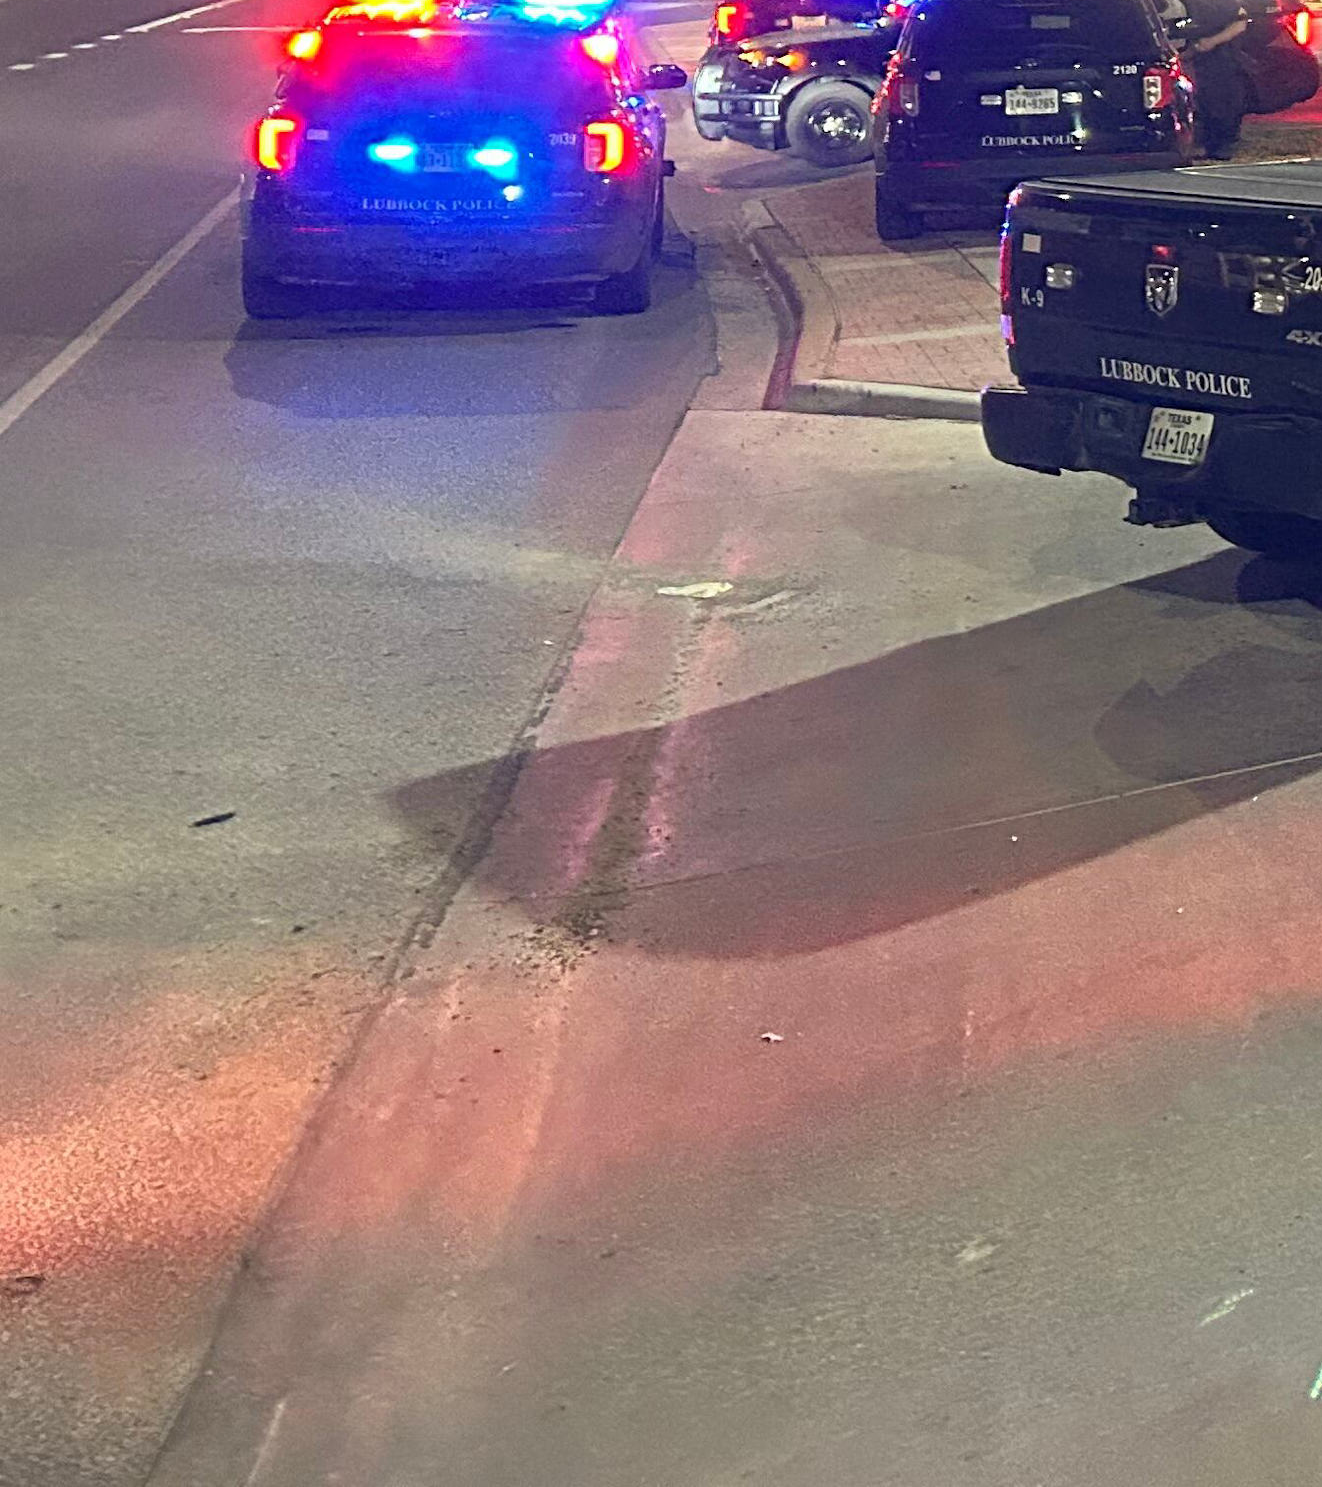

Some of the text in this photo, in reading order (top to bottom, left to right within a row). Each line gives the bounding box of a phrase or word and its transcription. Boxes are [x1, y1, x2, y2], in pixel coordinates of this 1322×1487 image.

[981, 135, 1040, 146] LUBBOCK
[362, 197, 517, 210] LUBBOCK POLICE
[1021, 286, 1044, 307] K-9
[1100, 357, 1252, 399] LUBBOCK POLICE
[1167, 412, 1192, 425] TEXAS
